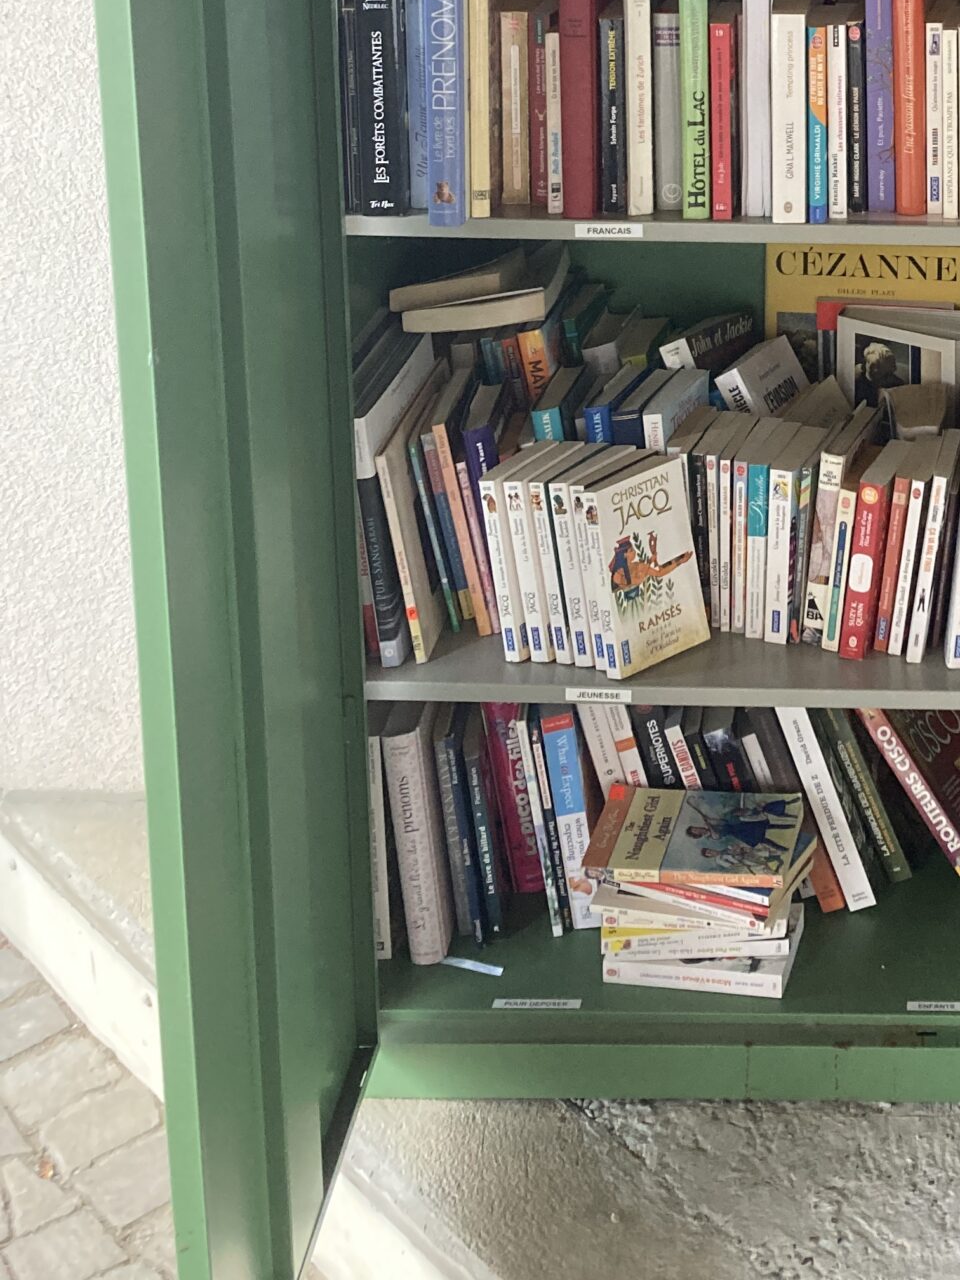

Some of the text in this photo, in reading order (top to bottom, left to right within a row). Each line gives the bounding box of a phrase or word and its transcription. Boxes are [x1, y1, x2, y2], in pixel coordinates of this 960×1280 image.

[371, 31, 384, 120] COMBATTANTES
[372, 122, 387, 164] FORÊTS
[692, 129, 705, 146] du
[775, 247, 957, 281] CÉZANNE
[611, 472, 669, 506] CHRISTIAN
[613, 489, 672, 535] JACQ
[647, 719, 675, 785] SUPERNOTES
[876, 726, 960, 853] ROUTEURS CISCO
[624, 821, 635, 832] The
[625, 795, 660, 860] Naughtiest Girl
[654, 816, 673, 841] Again
